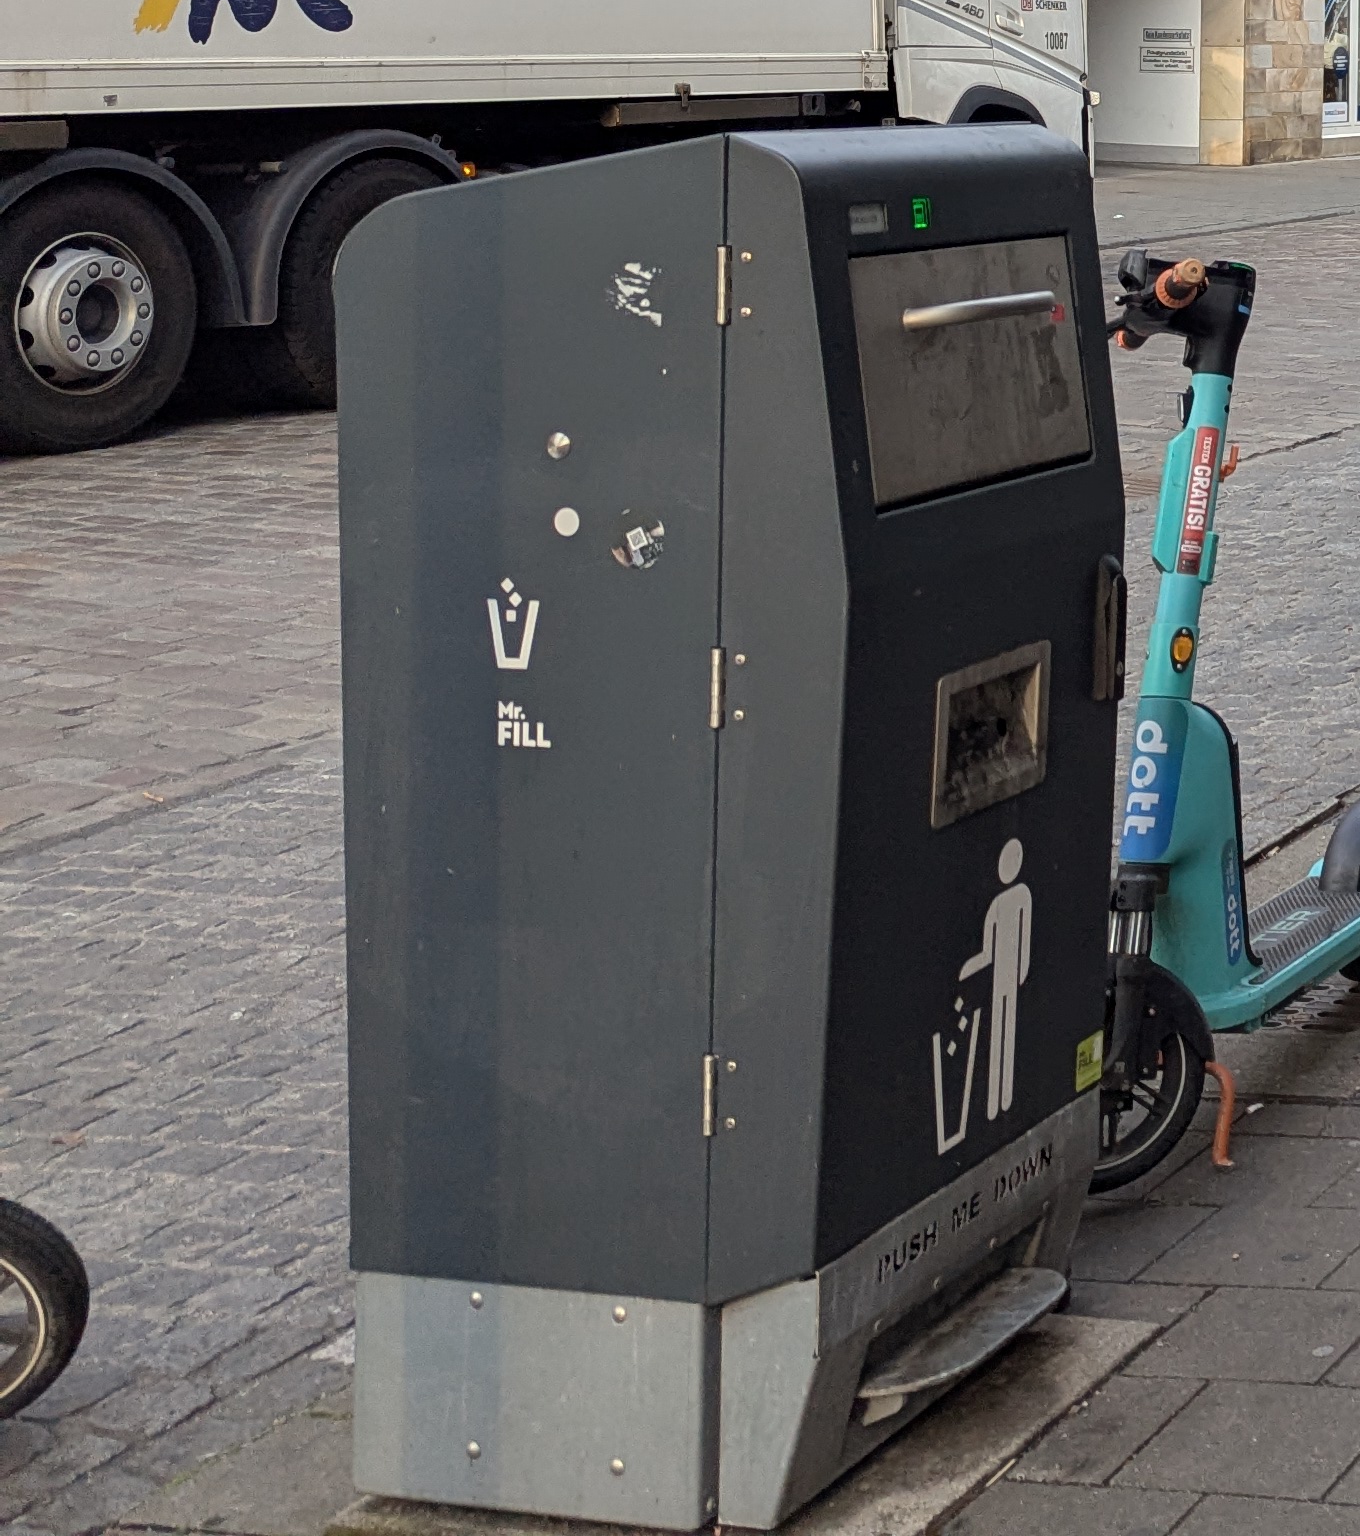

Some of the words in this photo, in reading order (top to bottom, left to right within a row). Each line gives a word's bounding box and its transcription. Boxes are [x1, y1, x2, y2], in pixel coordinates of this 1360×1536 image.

[1035, 0, 1067, 11] SCHENKER
[1044, 32, 1068, 50] 10087
[1185, 465, 1212, 531] GRATIS!
[498, 700, 526, 720] Mr.
[498, 720, 552, 748] FILL
[1123, 719, 1168, 836] dott
[1227, 897, 1240, 957] dott
[1249, 910, 1321, 945] TIER
[878, 1220, 938, 1283] PUSH
[952, 1191, 982, 1233] ME
[994, 1143, 1053, 1202] DOWN
